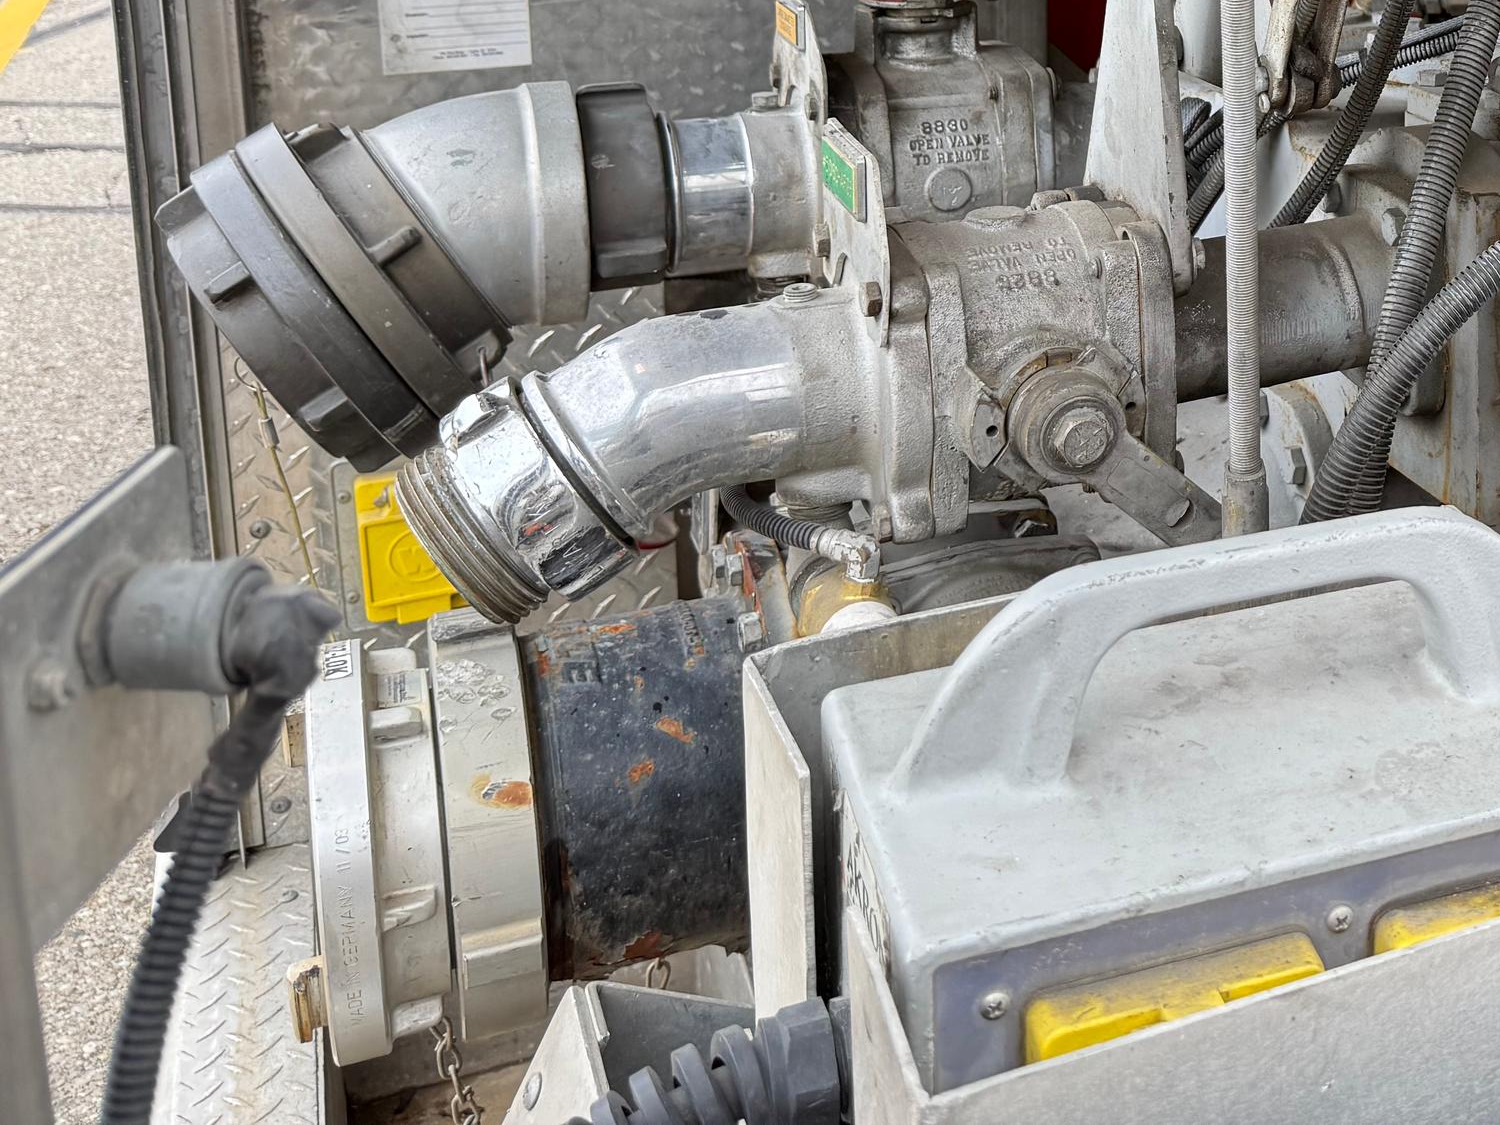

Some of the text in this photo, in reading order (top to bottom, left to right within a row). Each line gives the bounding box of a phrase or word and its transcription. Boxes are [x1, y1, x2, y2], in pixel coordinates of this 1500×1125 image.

[909, 134, 990, 152] OPEN VALVE
[912, 148, 990, 166] TO REMOVE
[338, 885, 359, 967] GERMANY
